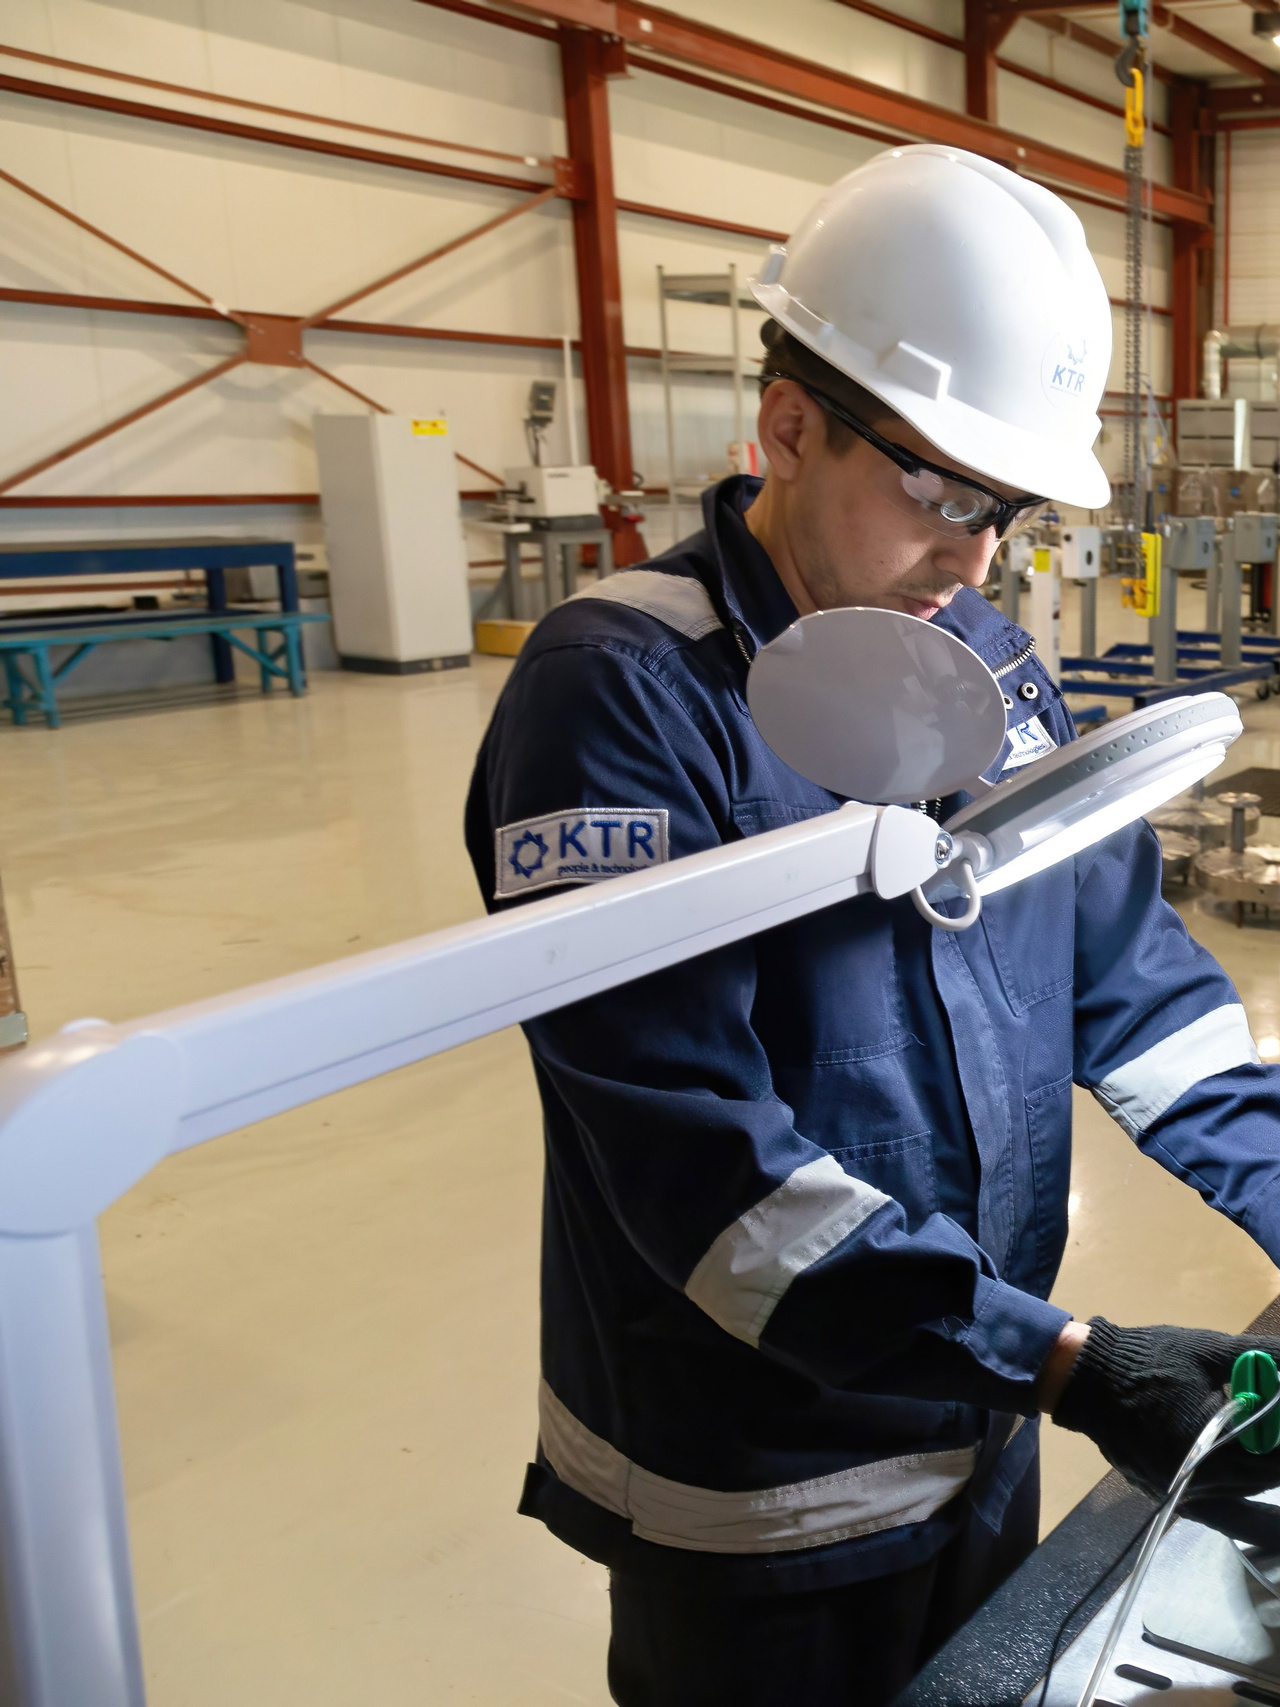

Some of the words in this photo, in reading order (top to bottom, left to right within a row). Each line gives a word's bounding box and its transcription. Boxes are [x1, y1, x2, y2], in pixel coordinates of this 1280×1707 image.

[1052, 364, 1085, 392] KTR
[559, 820, 655, 859] KTR
[558, 862, 589, 876] people
[591, 862, 599, 873] &
